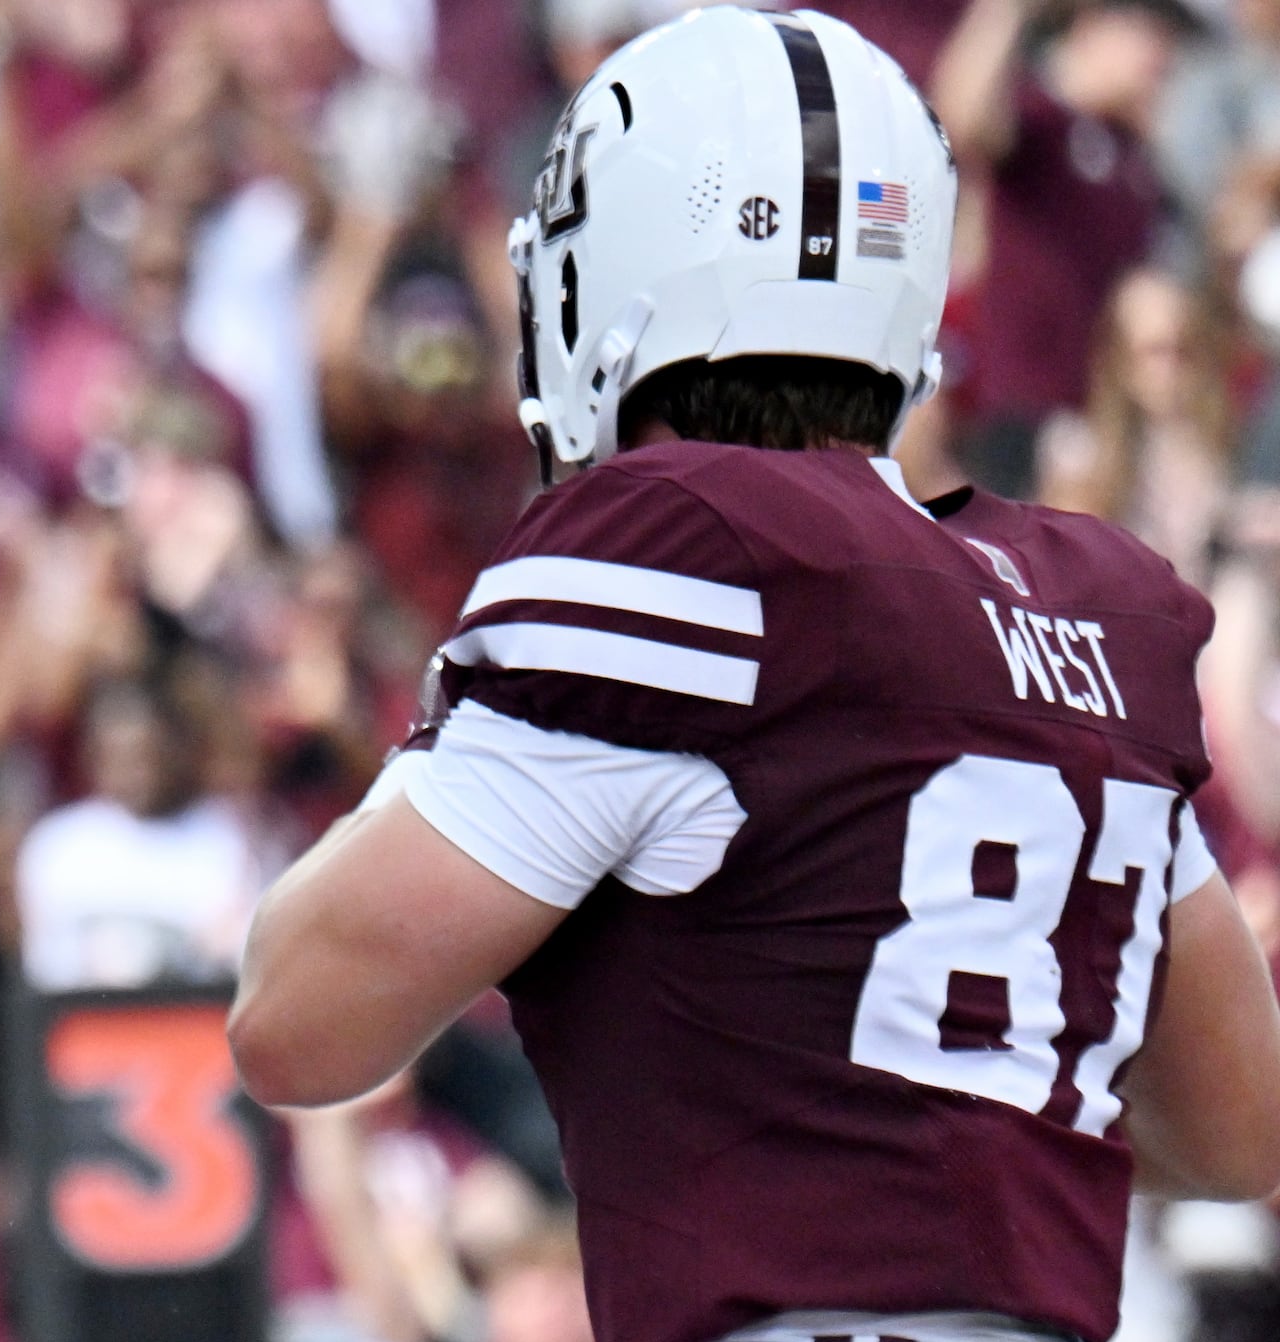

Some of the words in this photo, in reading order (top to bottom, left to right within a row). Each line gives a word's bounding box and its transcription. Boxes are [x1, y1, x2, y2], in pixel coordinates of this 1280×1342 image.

[738, 196, 781, 241] SEC
[808, 236, 833, 256] 87
[980, 598, 1127, 721] WEST
[850, 753, 1183, 1140] 87
[46, 1005, 260, 1272] 3
